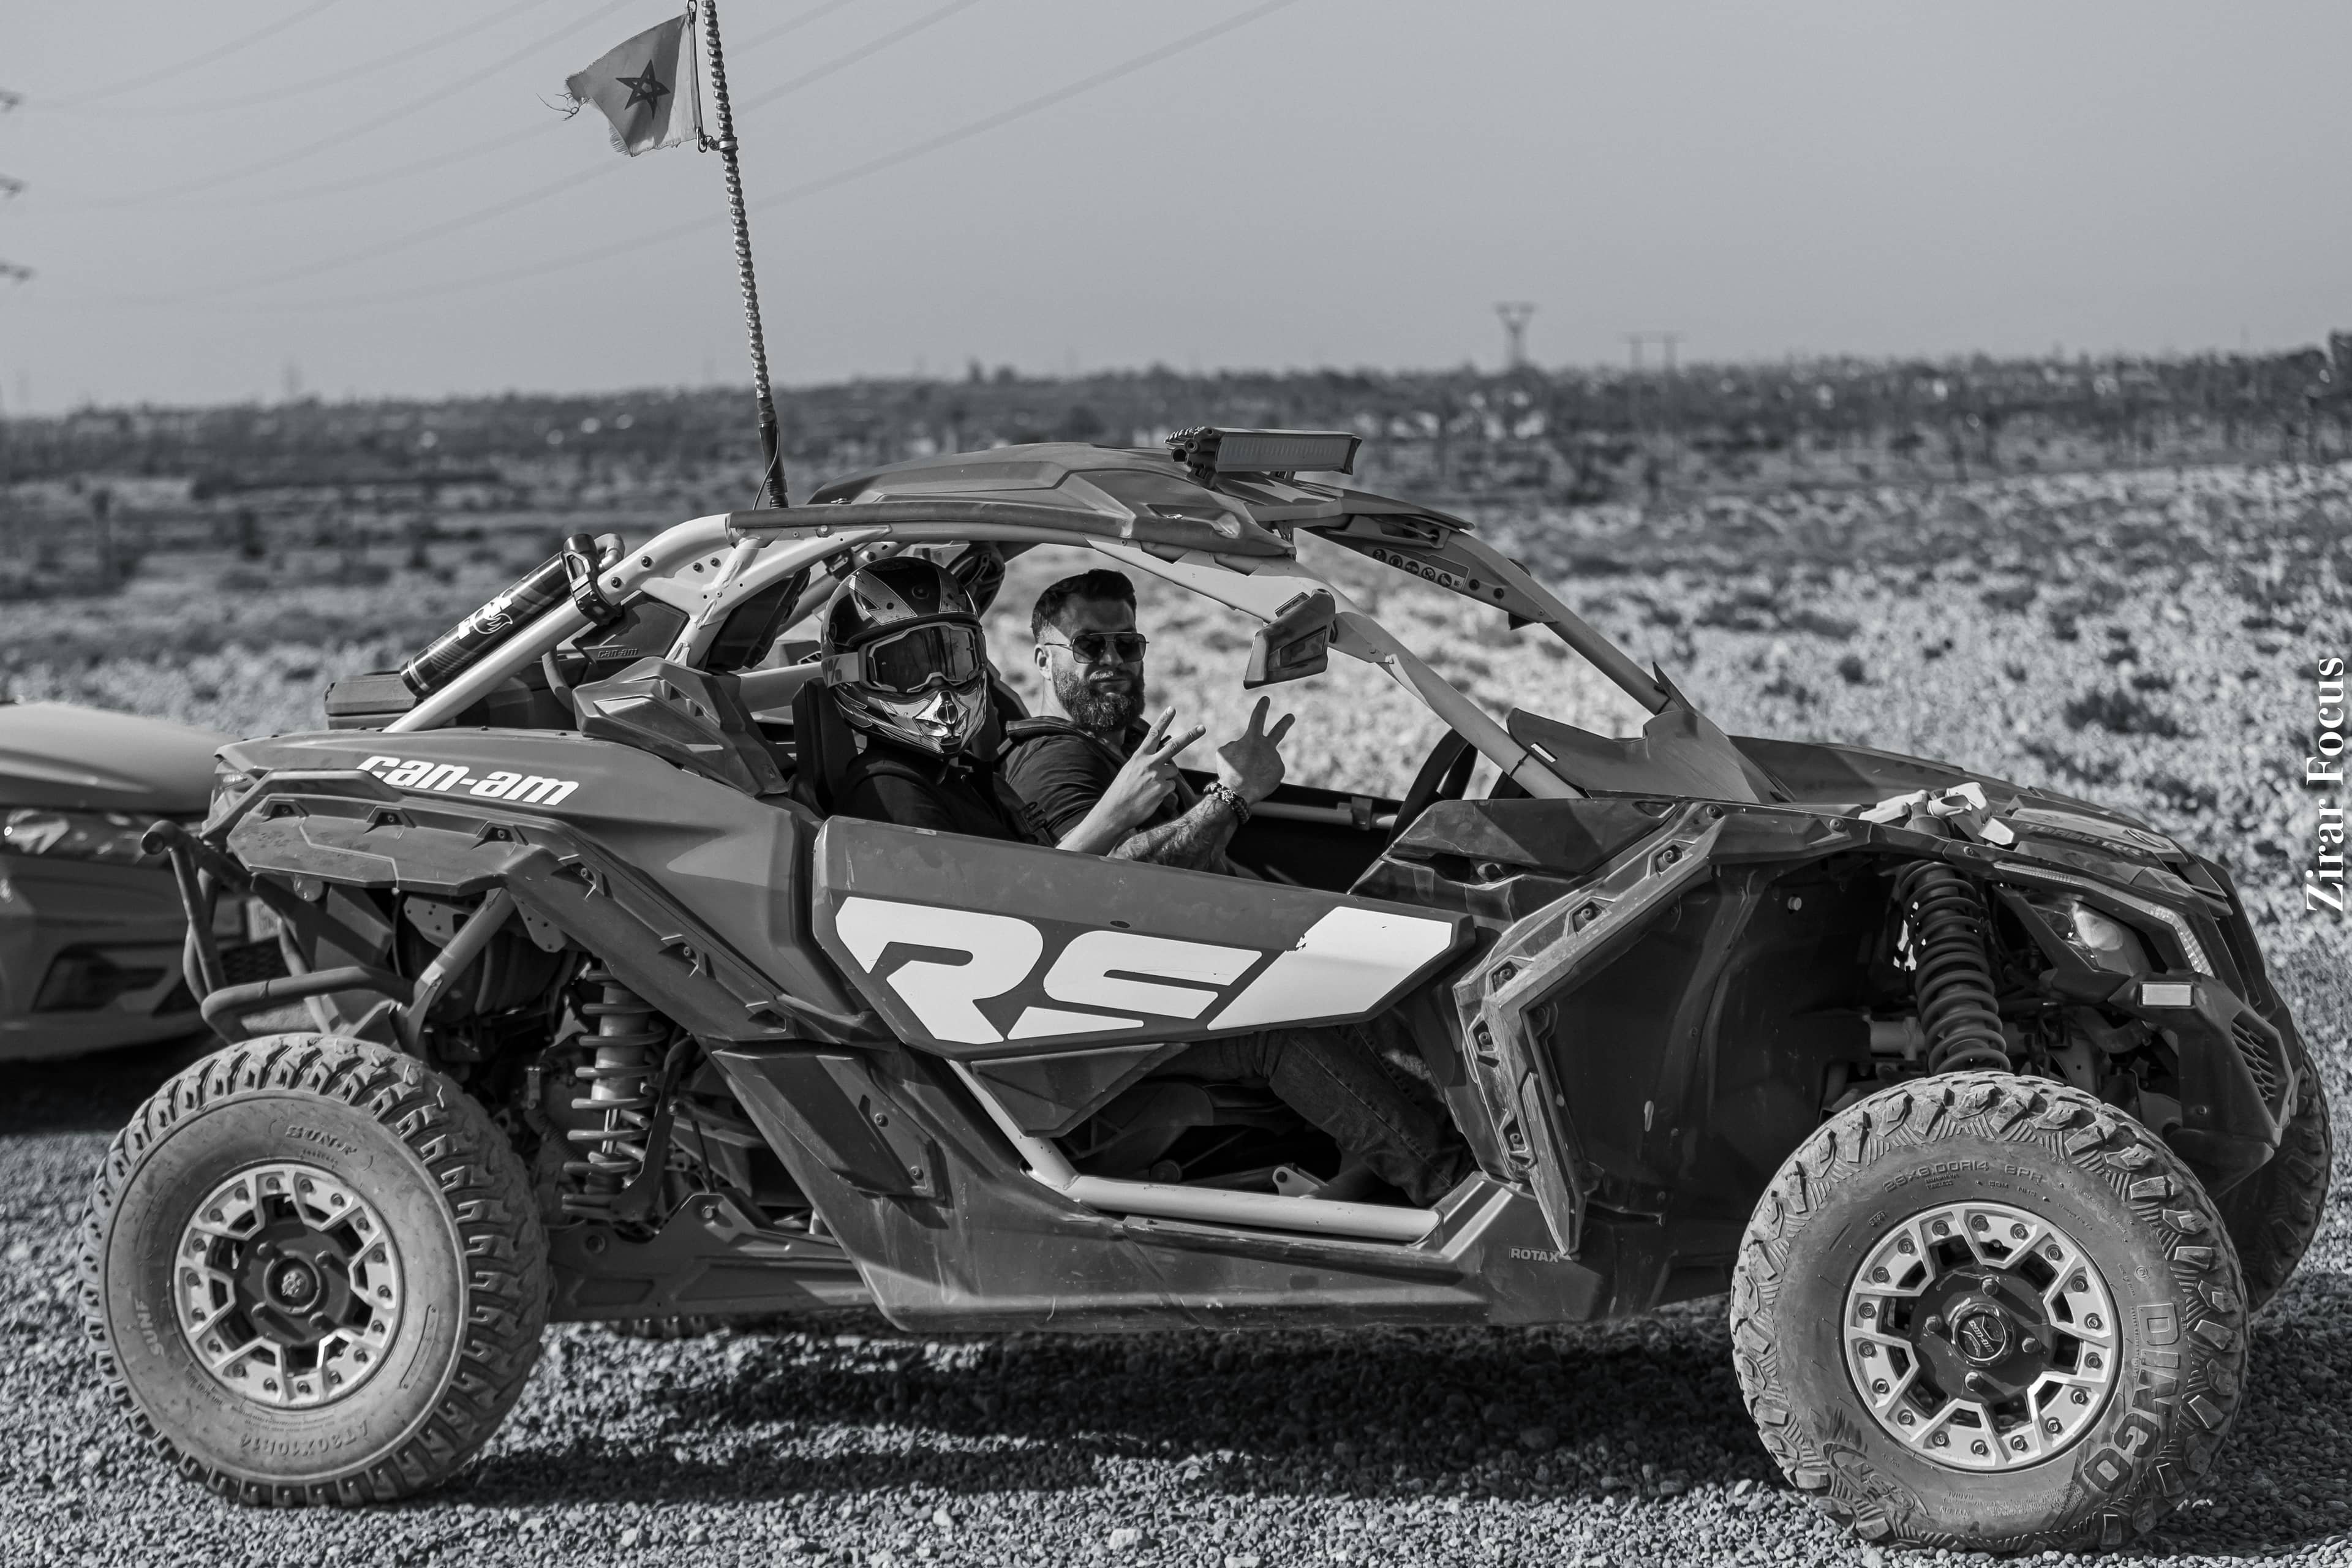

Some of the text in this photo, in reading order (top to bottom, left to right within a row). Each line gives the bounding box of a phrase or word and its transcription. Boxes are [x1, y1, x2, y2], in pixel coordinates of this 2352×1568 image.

[597, 647, 639, 659] can-am
[356, 755, 579, 806] can-am
[1510, 1248, 1559, 1264] ROTAX
[2083, 1302, 2180, 1493] DINGO
